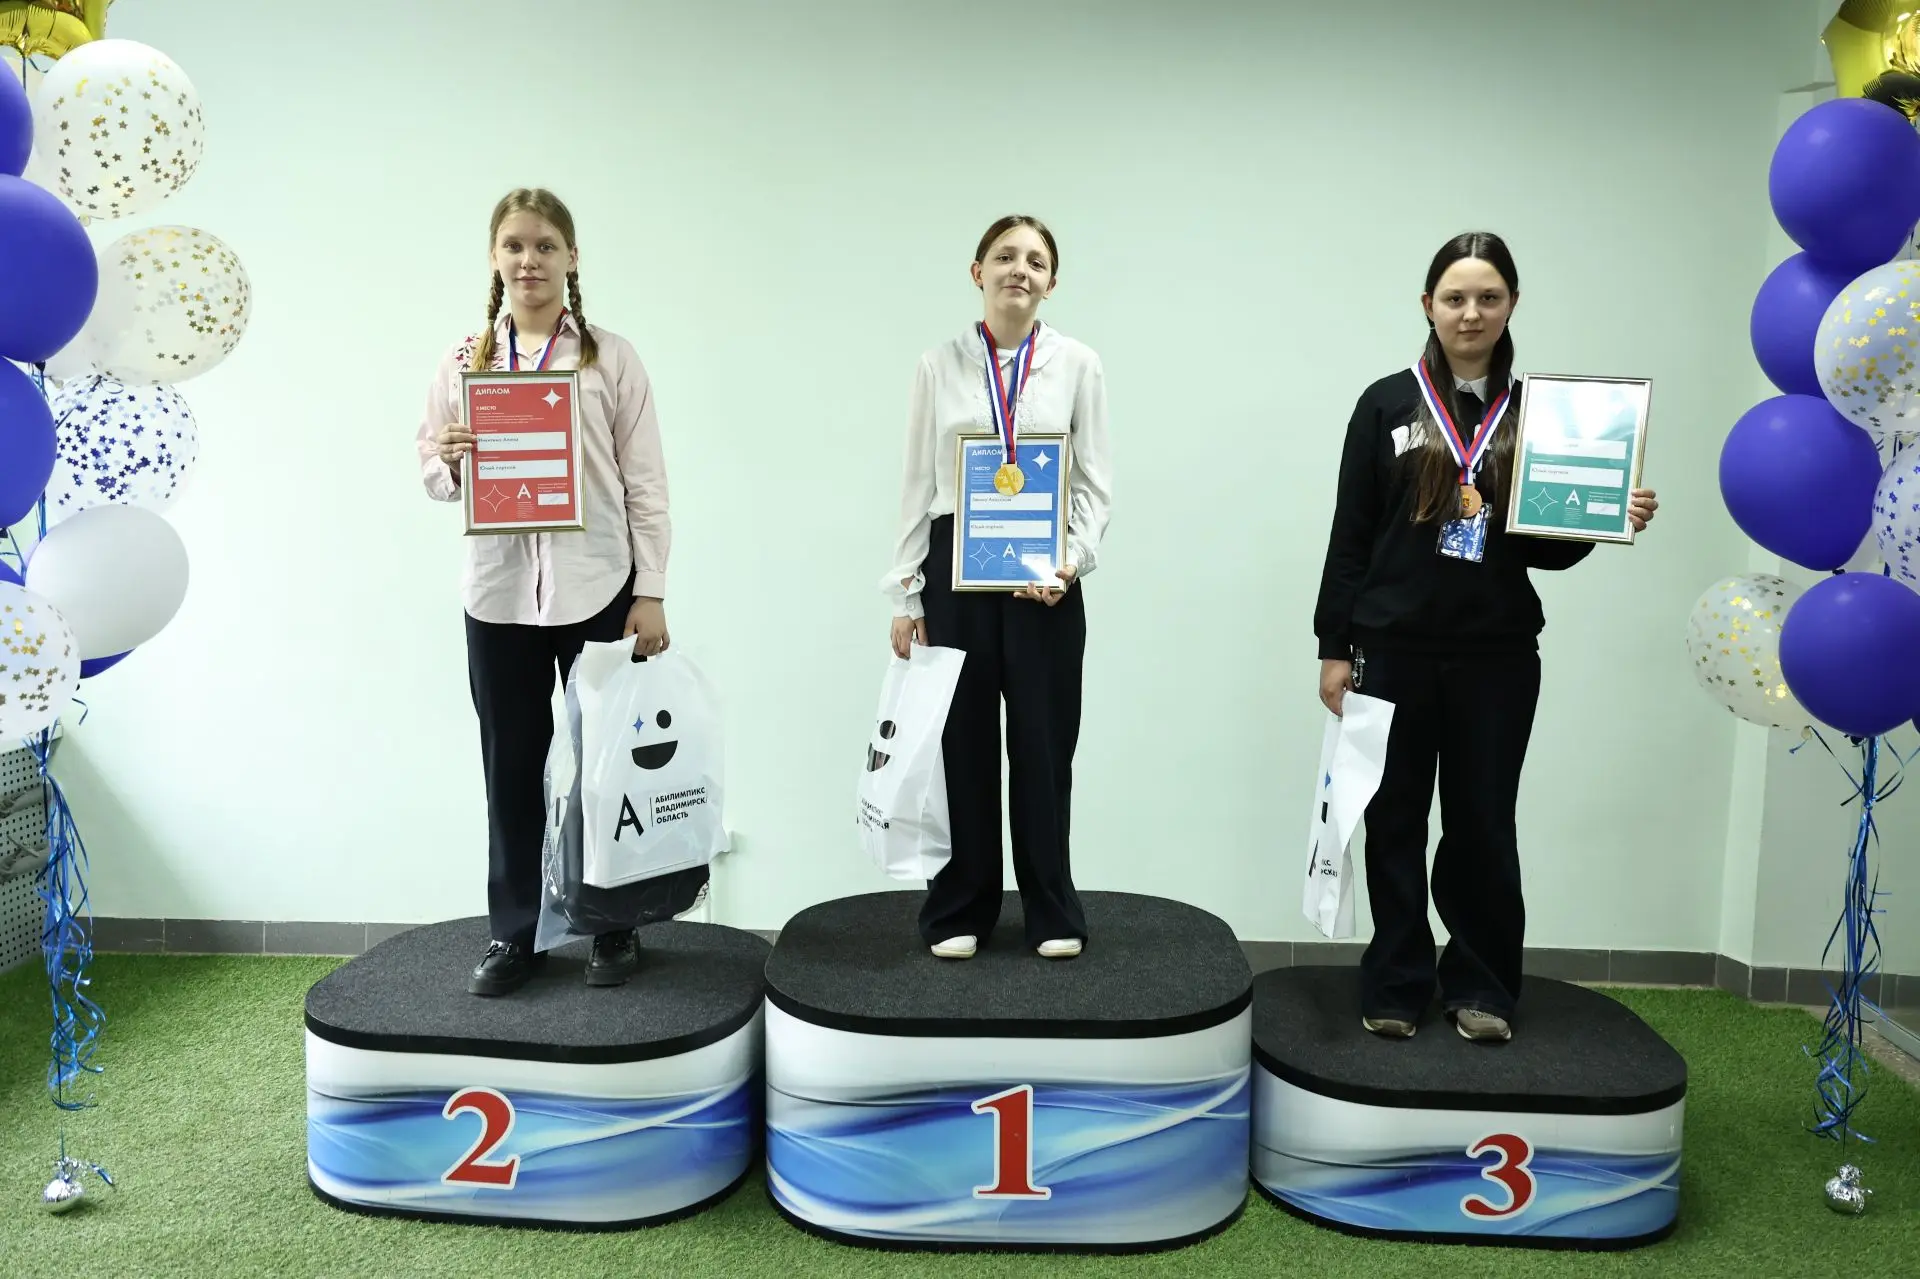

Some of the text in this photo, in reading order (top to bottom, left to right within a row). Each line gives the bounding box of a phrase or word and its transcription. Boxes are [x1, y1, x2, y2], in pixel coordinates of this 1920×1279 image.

[517, 482, 532, 499] А
[1565, 488, 1581, 506] А
[1003, 542, 1016, 558] А
[655, 787, 706, 804] АБИЛИМПИКС
[655, 796, 708, 814] ВЛАДИМИРСК
[614, 793, 645, 842] А
[656, 811, 689, 824] ОБЛАСТЬ
[442, 1087, 520, 1189] 2
[972, 1085, 1051, 1199] 1
[1461, 1131, 1537, 1221] 3
